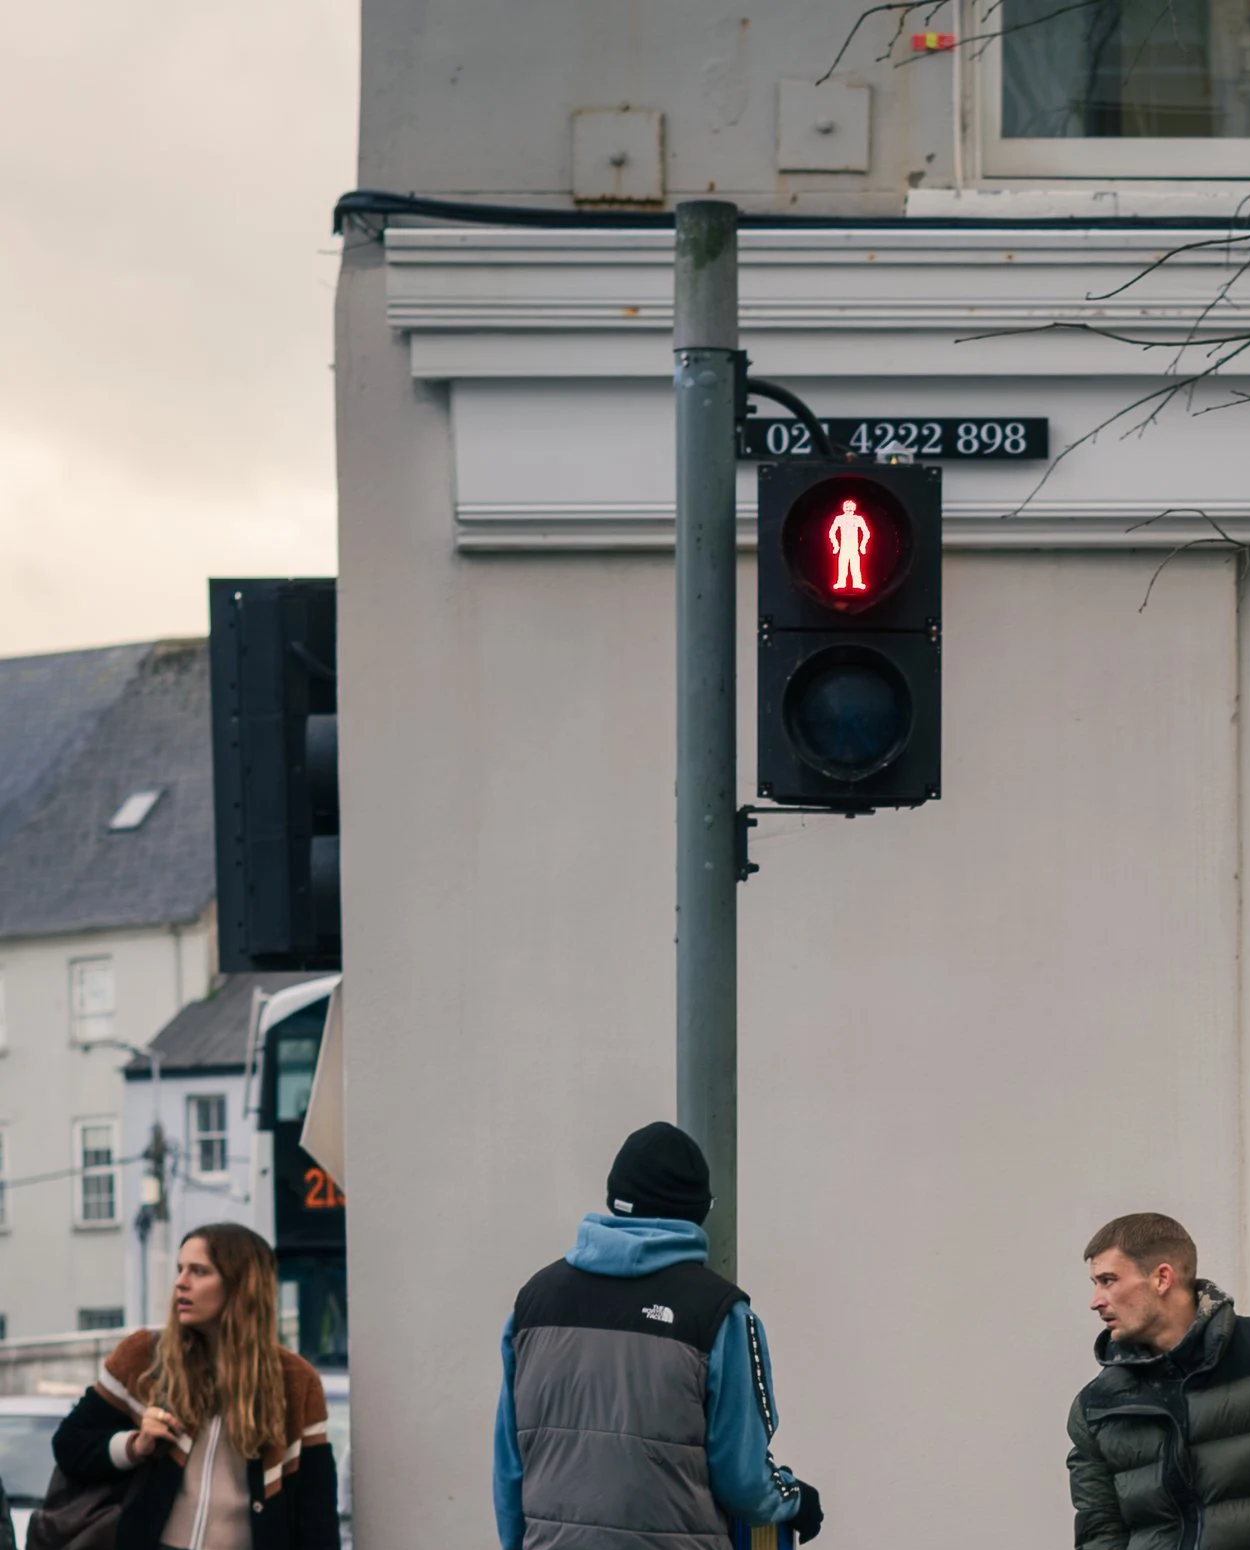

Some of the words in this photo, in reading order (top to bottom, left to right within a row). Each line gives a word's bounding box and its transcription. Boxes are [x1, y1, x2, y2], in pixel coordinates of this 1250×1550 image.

[766, 423, 829, 454] 02
[850, 423, 943, 454] 4222
[957, 423, 1026, 454] 898
[304, 1167, 347, 1207] 21
